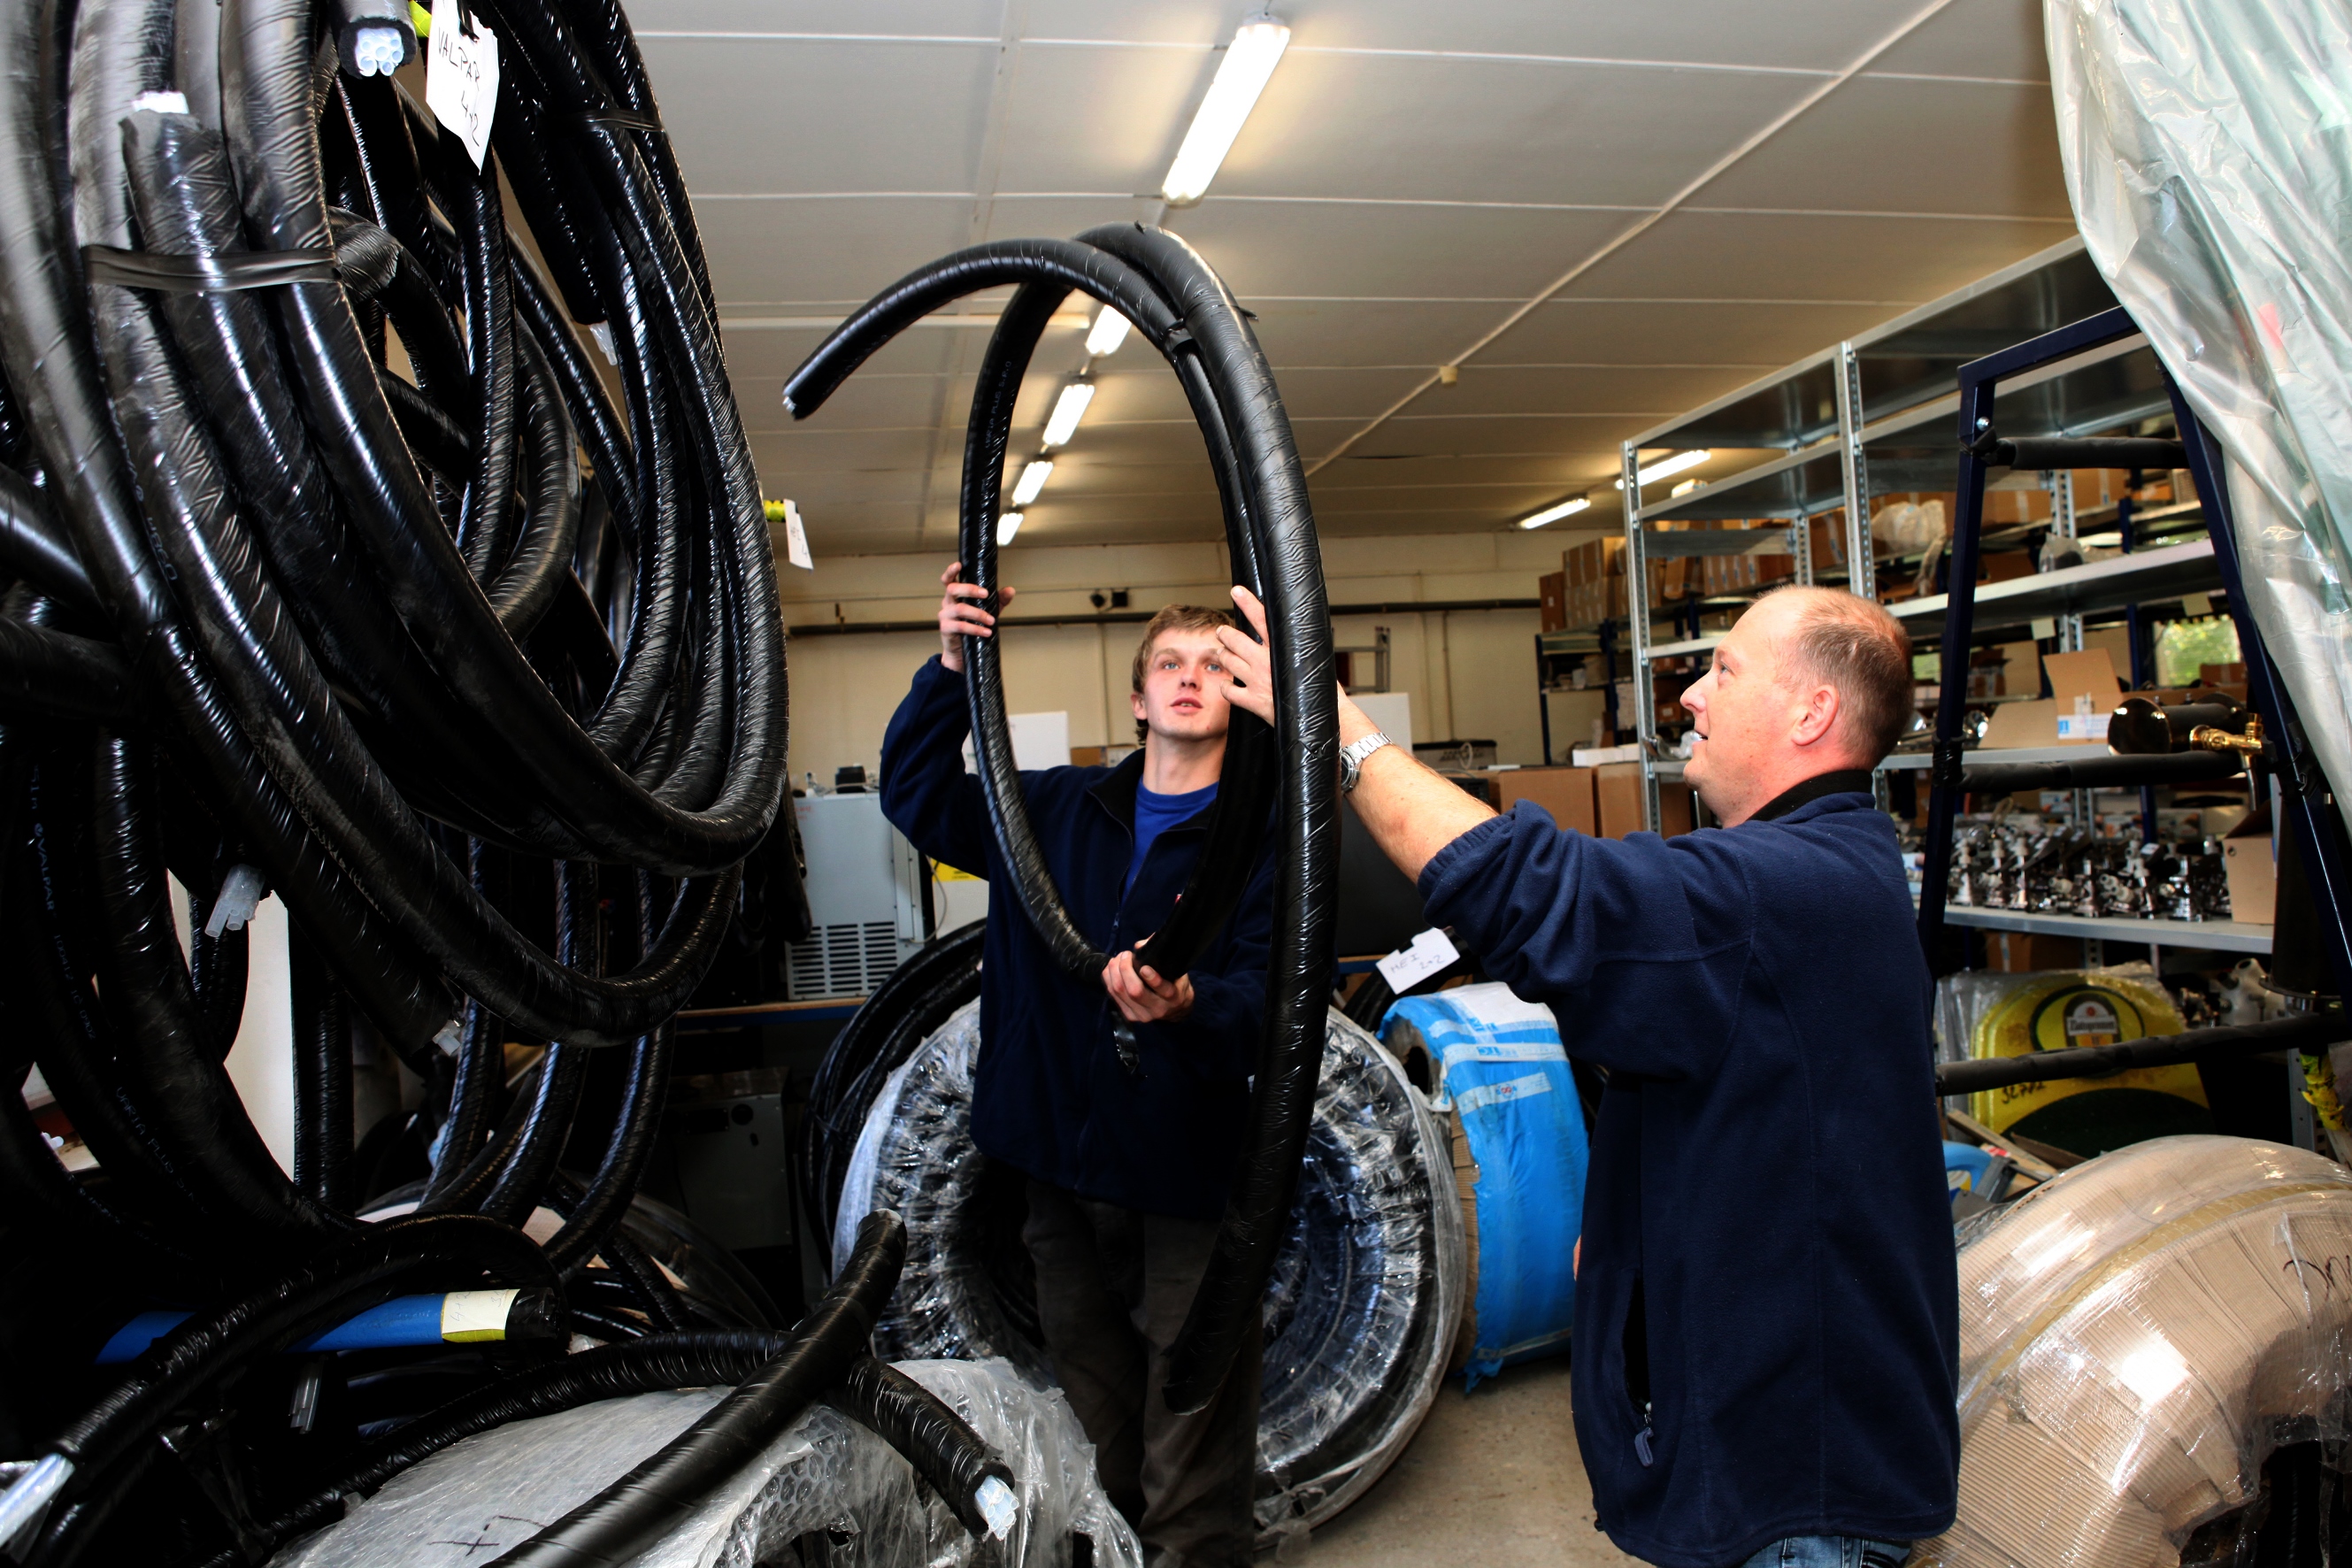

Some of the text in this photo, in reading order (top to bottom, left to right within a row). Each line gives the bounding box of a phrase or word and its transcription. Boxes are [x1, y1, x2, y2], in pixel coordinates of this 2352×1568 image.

[438, 27, 480, 91] VALPAR
[989, 389, 1003, 416] PLUS
[115, 1086, 146, 1135] VARIA
[146, 1138, 174, 1174] PLUS
